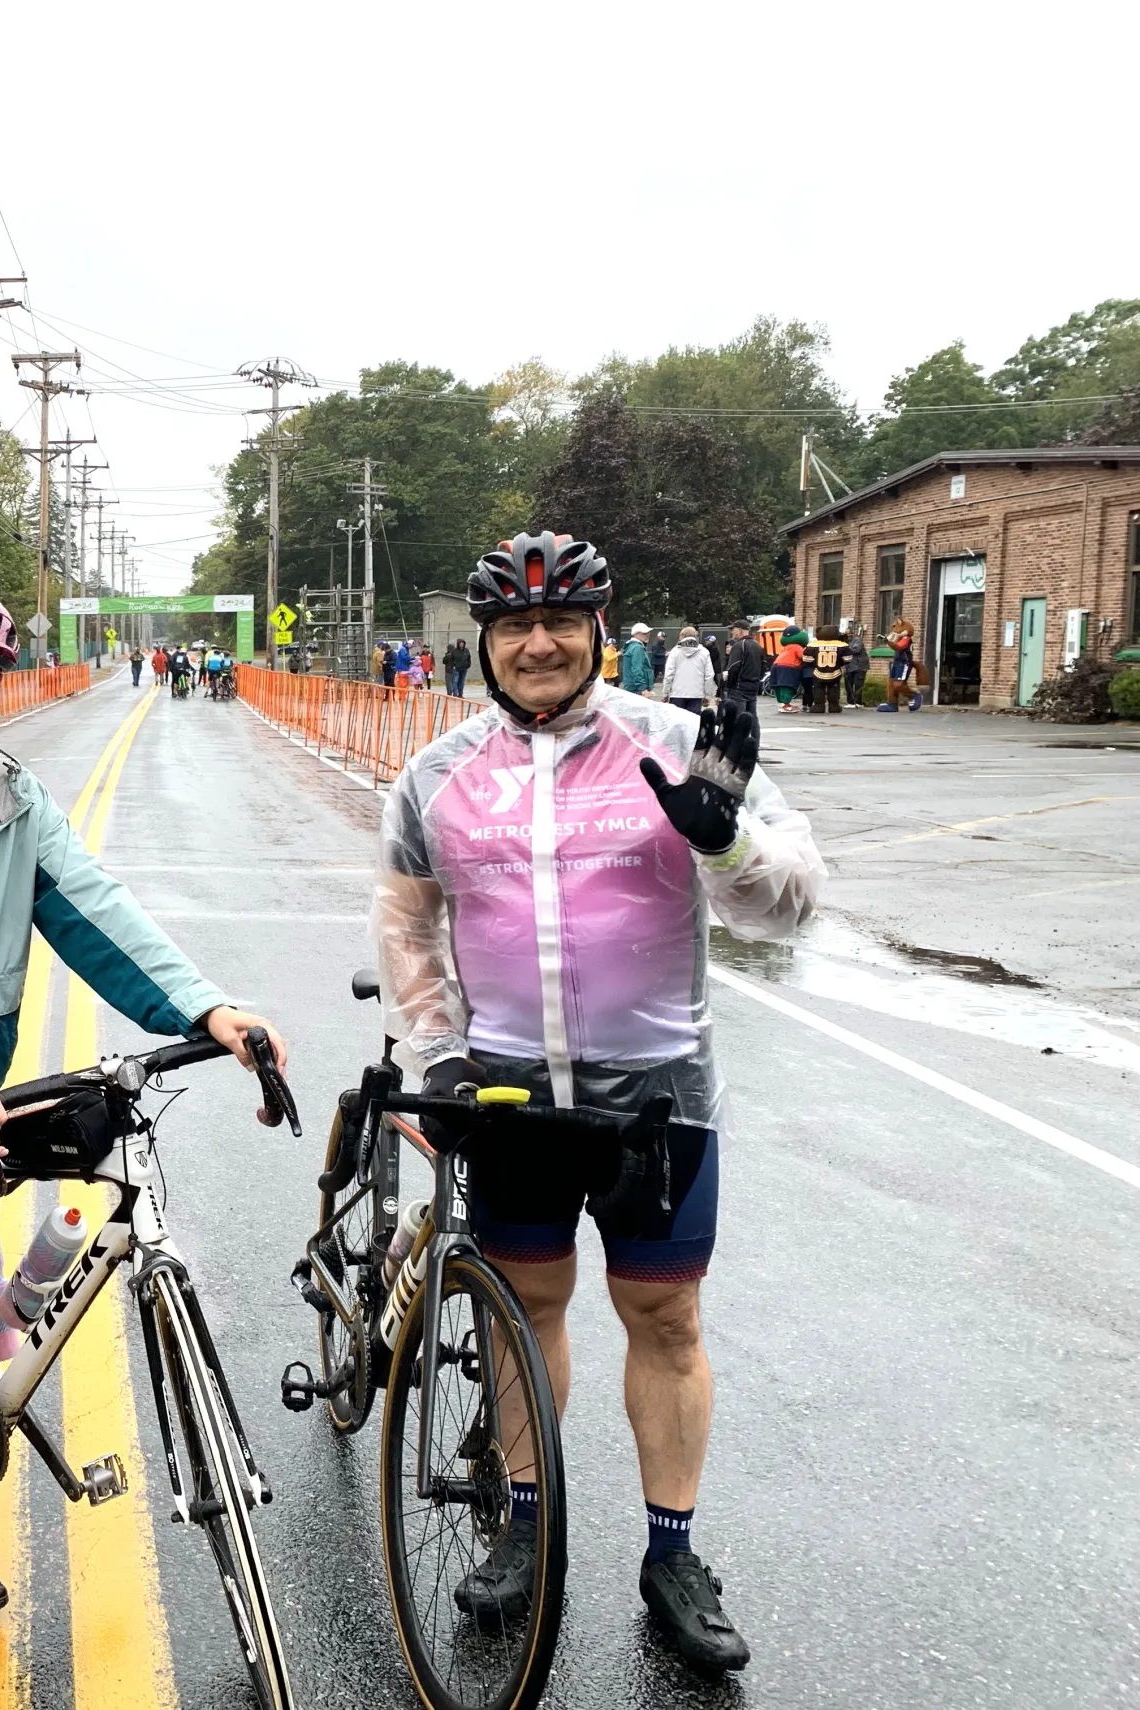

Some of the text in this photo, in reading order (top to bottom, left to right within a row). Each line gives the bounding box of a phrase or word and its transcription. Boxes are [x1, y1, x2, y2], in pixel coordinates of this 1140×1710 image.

[817, 651, 837, 668] 00
[470, 789, 492, 801] the
[469, 816, 651, 842] METROEST YMCA
[269, 1074, 295, 1119] ULTEGRA
[50, 1144, 79, 1155] WILD MAN
[146, 1181, 164, 1231] TREK
[452, 1153, 468, 1221] BMC
[24, 1229, 109, 1351] TREK
[380, 1246, 428, 1352] BMC
